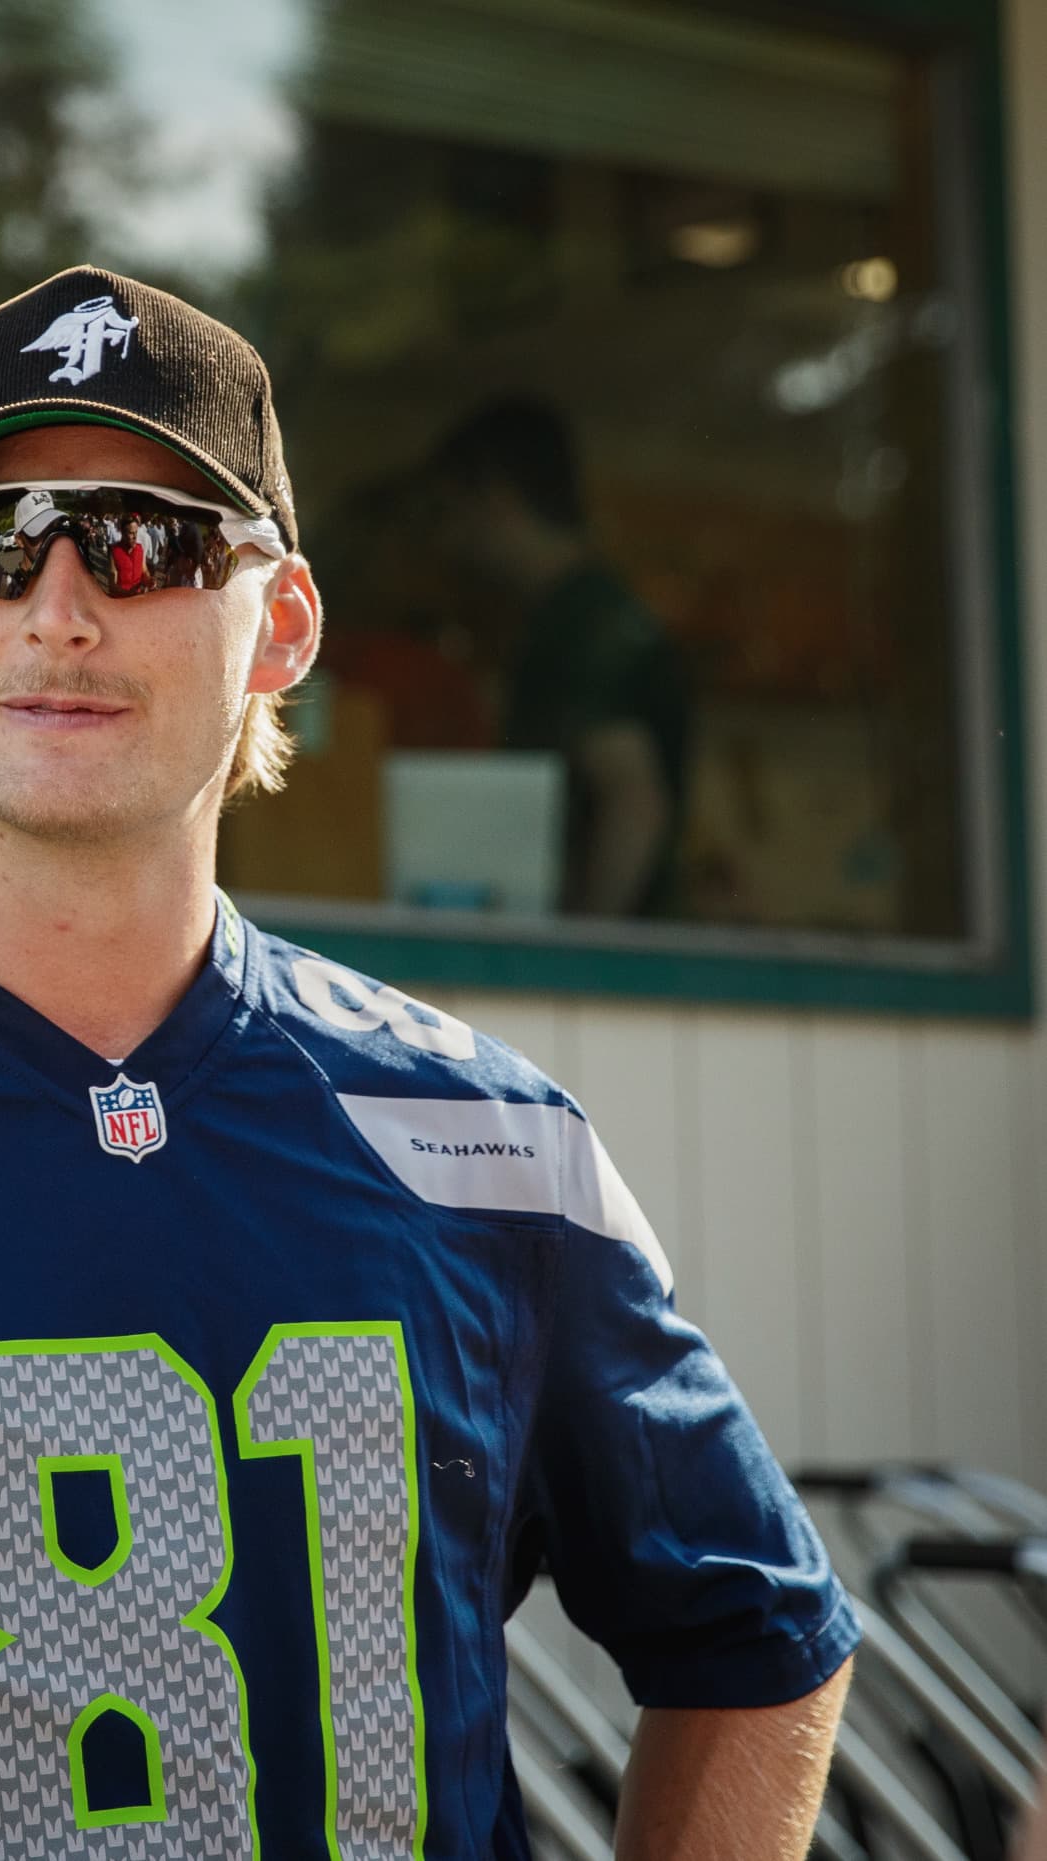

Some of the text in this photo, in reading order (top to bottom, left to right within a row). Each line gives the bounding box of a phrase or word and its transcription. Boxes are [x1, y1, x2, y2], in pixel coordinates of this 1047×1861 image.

[290, 948, 476, 1061] 8
[107, 1111, 157, 1146] NFL
[410, 1138, 535, 1158] SEAHAWKS
